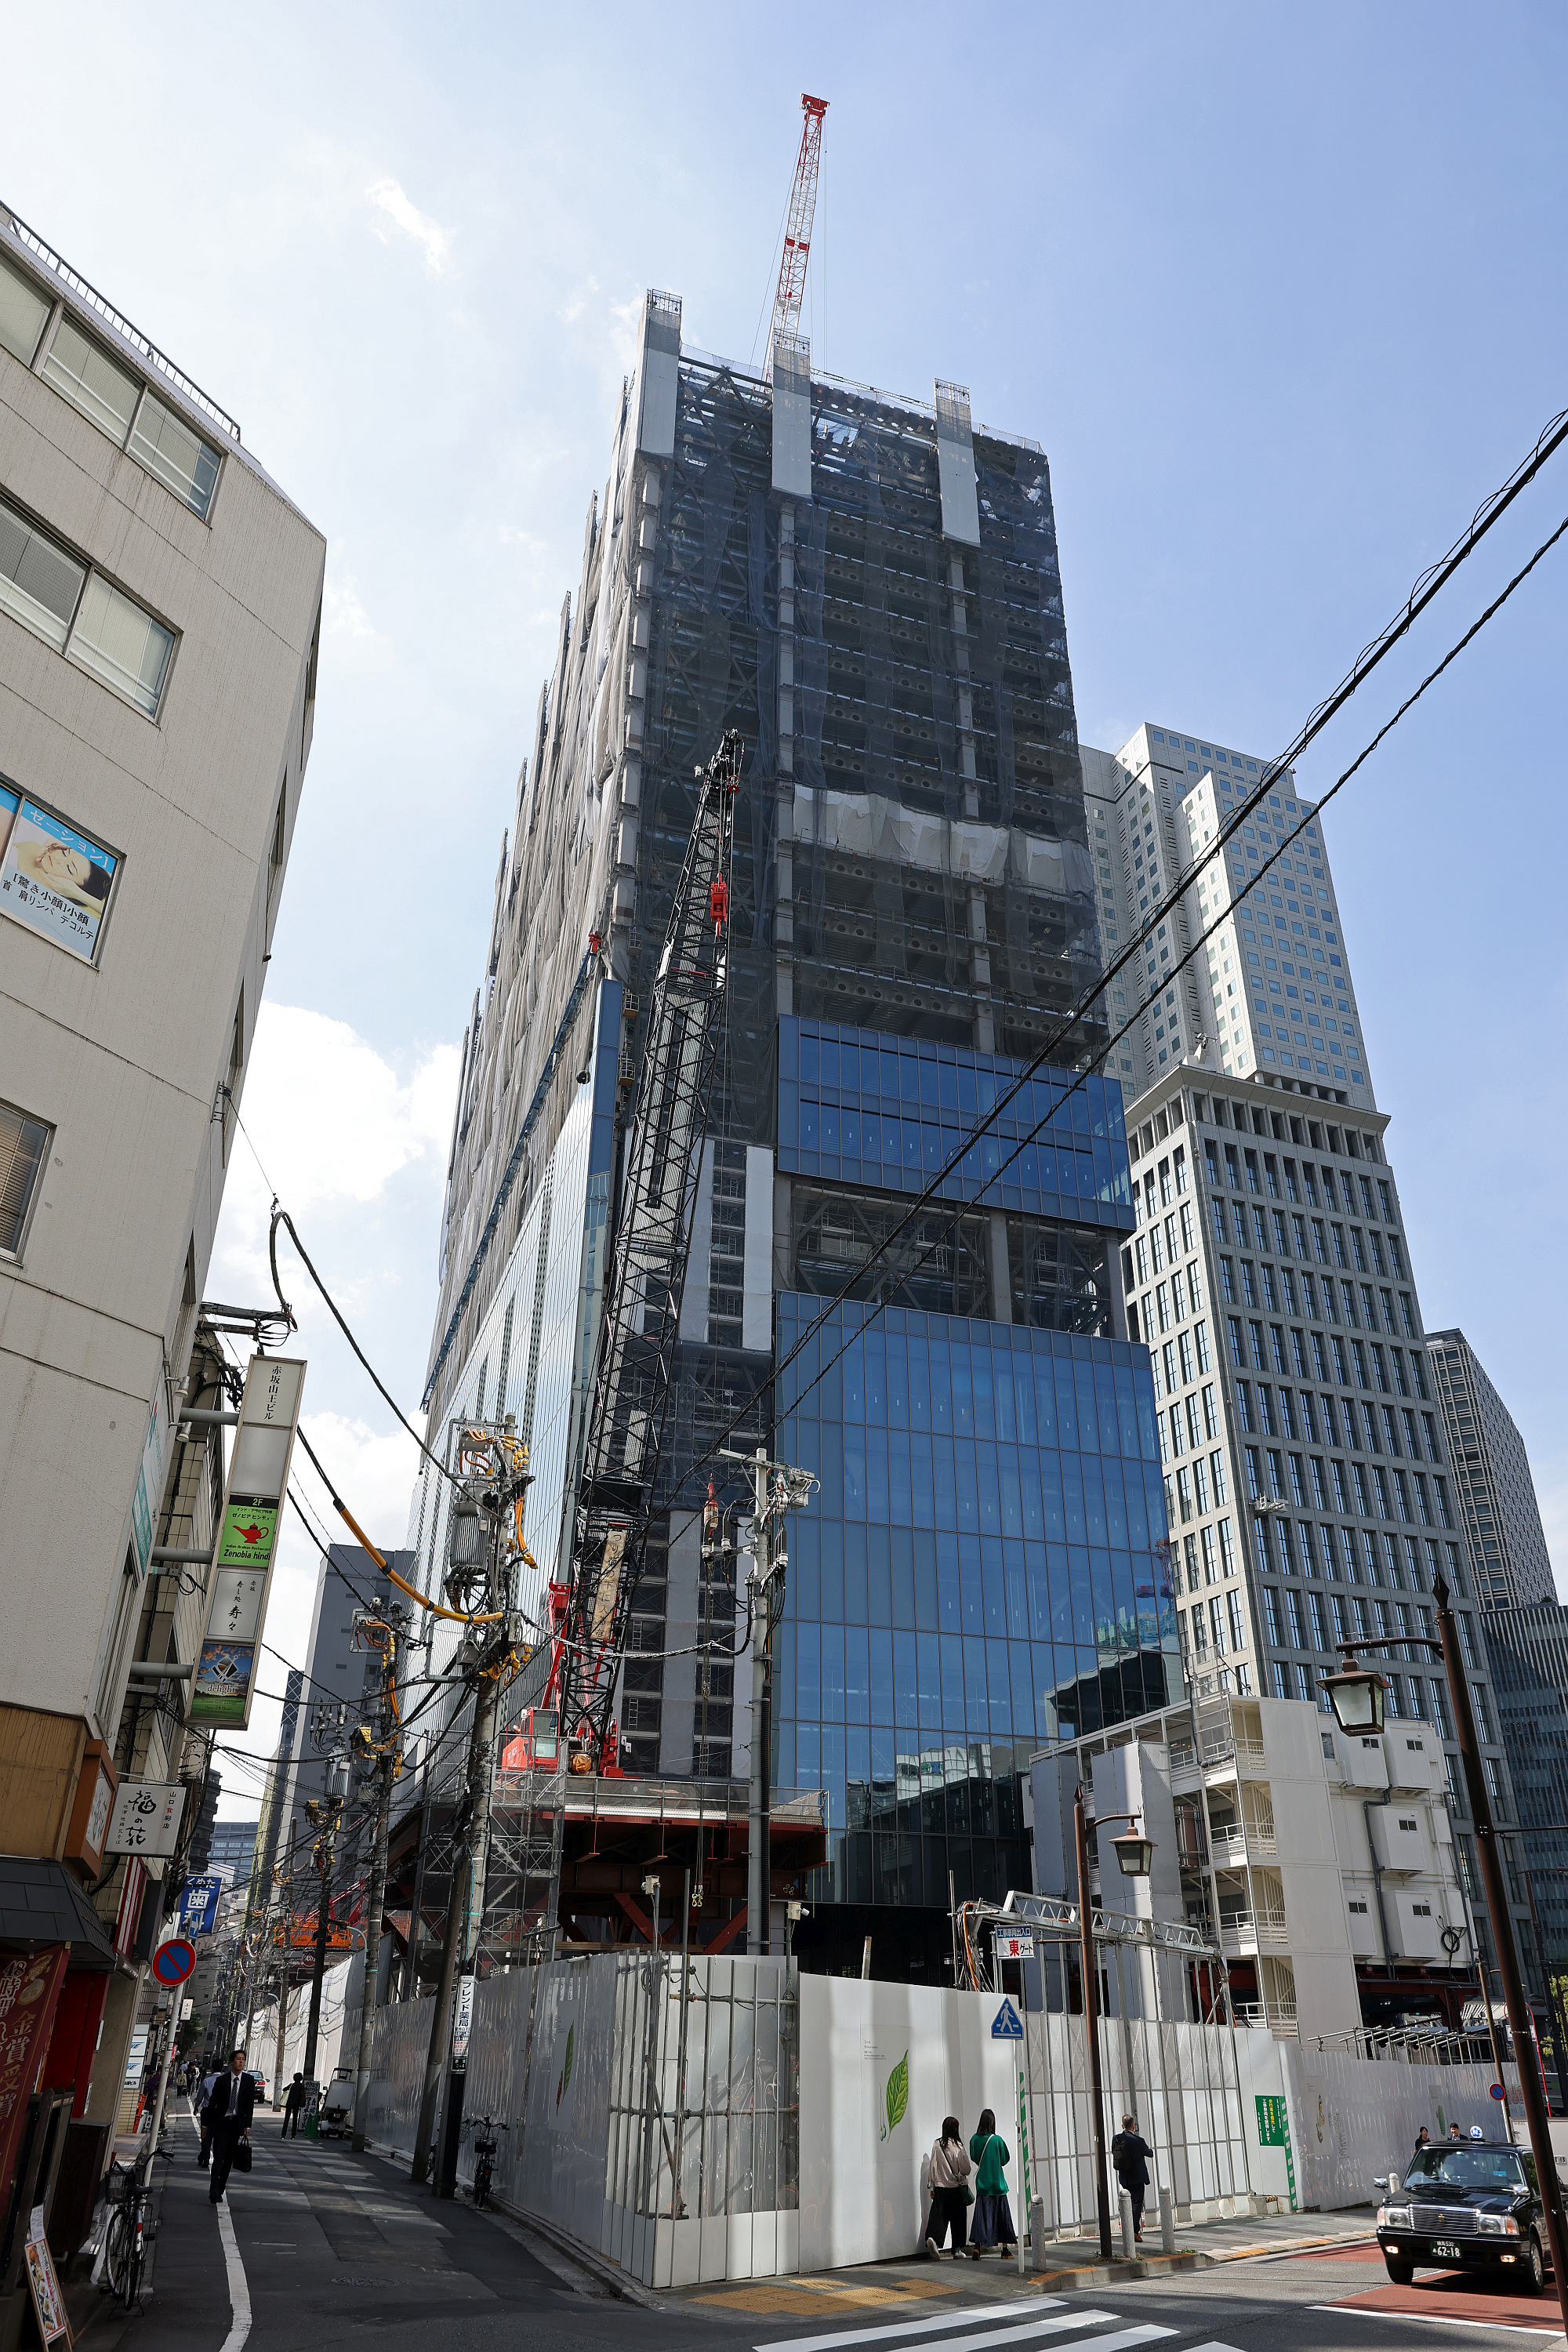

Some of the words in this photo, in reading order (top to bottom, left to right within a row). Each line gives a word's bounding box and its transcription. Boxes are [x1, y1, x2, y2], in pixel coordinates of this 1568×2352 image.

[2, 880, 13, 891] 首
[18, 890, 55, 915] 肩リンパ
[60, 915, 94, 940] デコルテ
[263, 1365, 282, 1420] 赤坂山王ビル
[252, 1497, 263, 1506] 2F
[223, 1549, 251, 1559] Zenobia
[249, 1580, 256, 1592] 赤坂
[207, 1683, 235, 1695] delight
[125, 1790, 157, 1846] 福の花
[162, 1791, 176, 1829] 山口食彩店
[997, 1928, 1031, 1937] 工事車両出入口
[459, 1982, 471, 2027] フレンド薬局
[0, 2010, 37, 2121] 金賞受賞
[1437, 2246, 1461, 2257] 62-18
